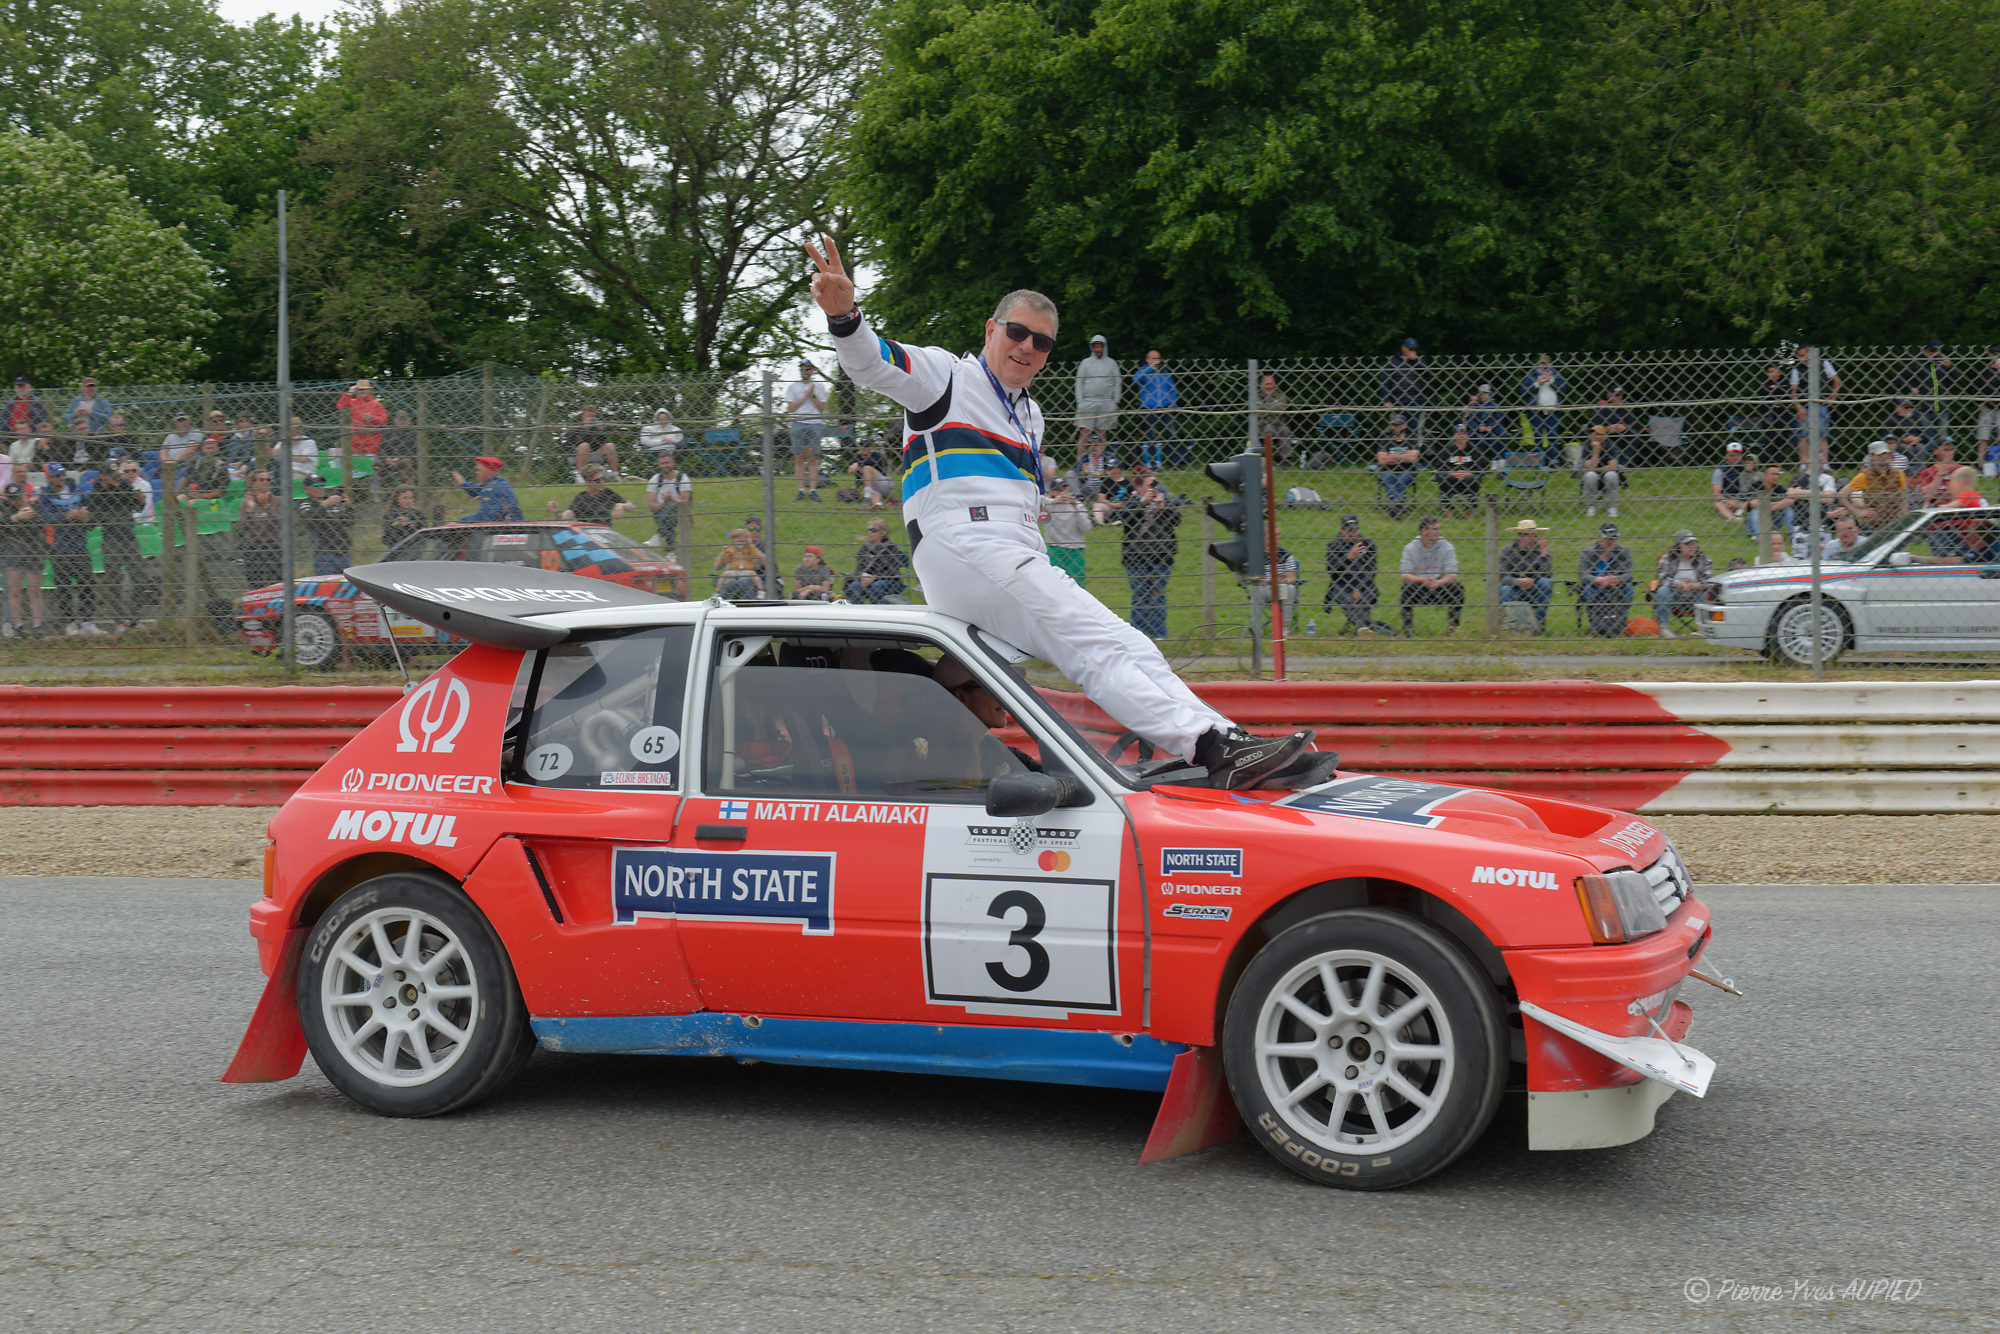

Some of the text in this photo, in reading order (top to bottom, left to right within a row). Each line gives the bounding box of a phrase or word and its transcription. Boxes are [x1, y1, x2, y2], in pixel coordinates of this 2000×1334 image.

[434, 587, 610, 603] PIONEER
[643, 736, 665, 754] 65
[539, 752, 559, 771] 72
[367, 773, 493, 794] PIONEER
[615, 773, 670, 784] ECURIE BRETAGNE
[754, 802, 926, 825] MATTI ALAMAKI
[327, 810, 458, 847] MOTUL
[1166, 854, 1237, 867] NORTH STATE
[624, 864, 818, 903] NORTH STATE
[1471, 866, 1560, 890] MOTUL
[1175, 884, 1242, 895] PIONEER
[1166, 905, 1230, 920] SERAZIN
[984, 889, 1051, 993] 3
[1258, 1112, 1361, 1177] COOPER
